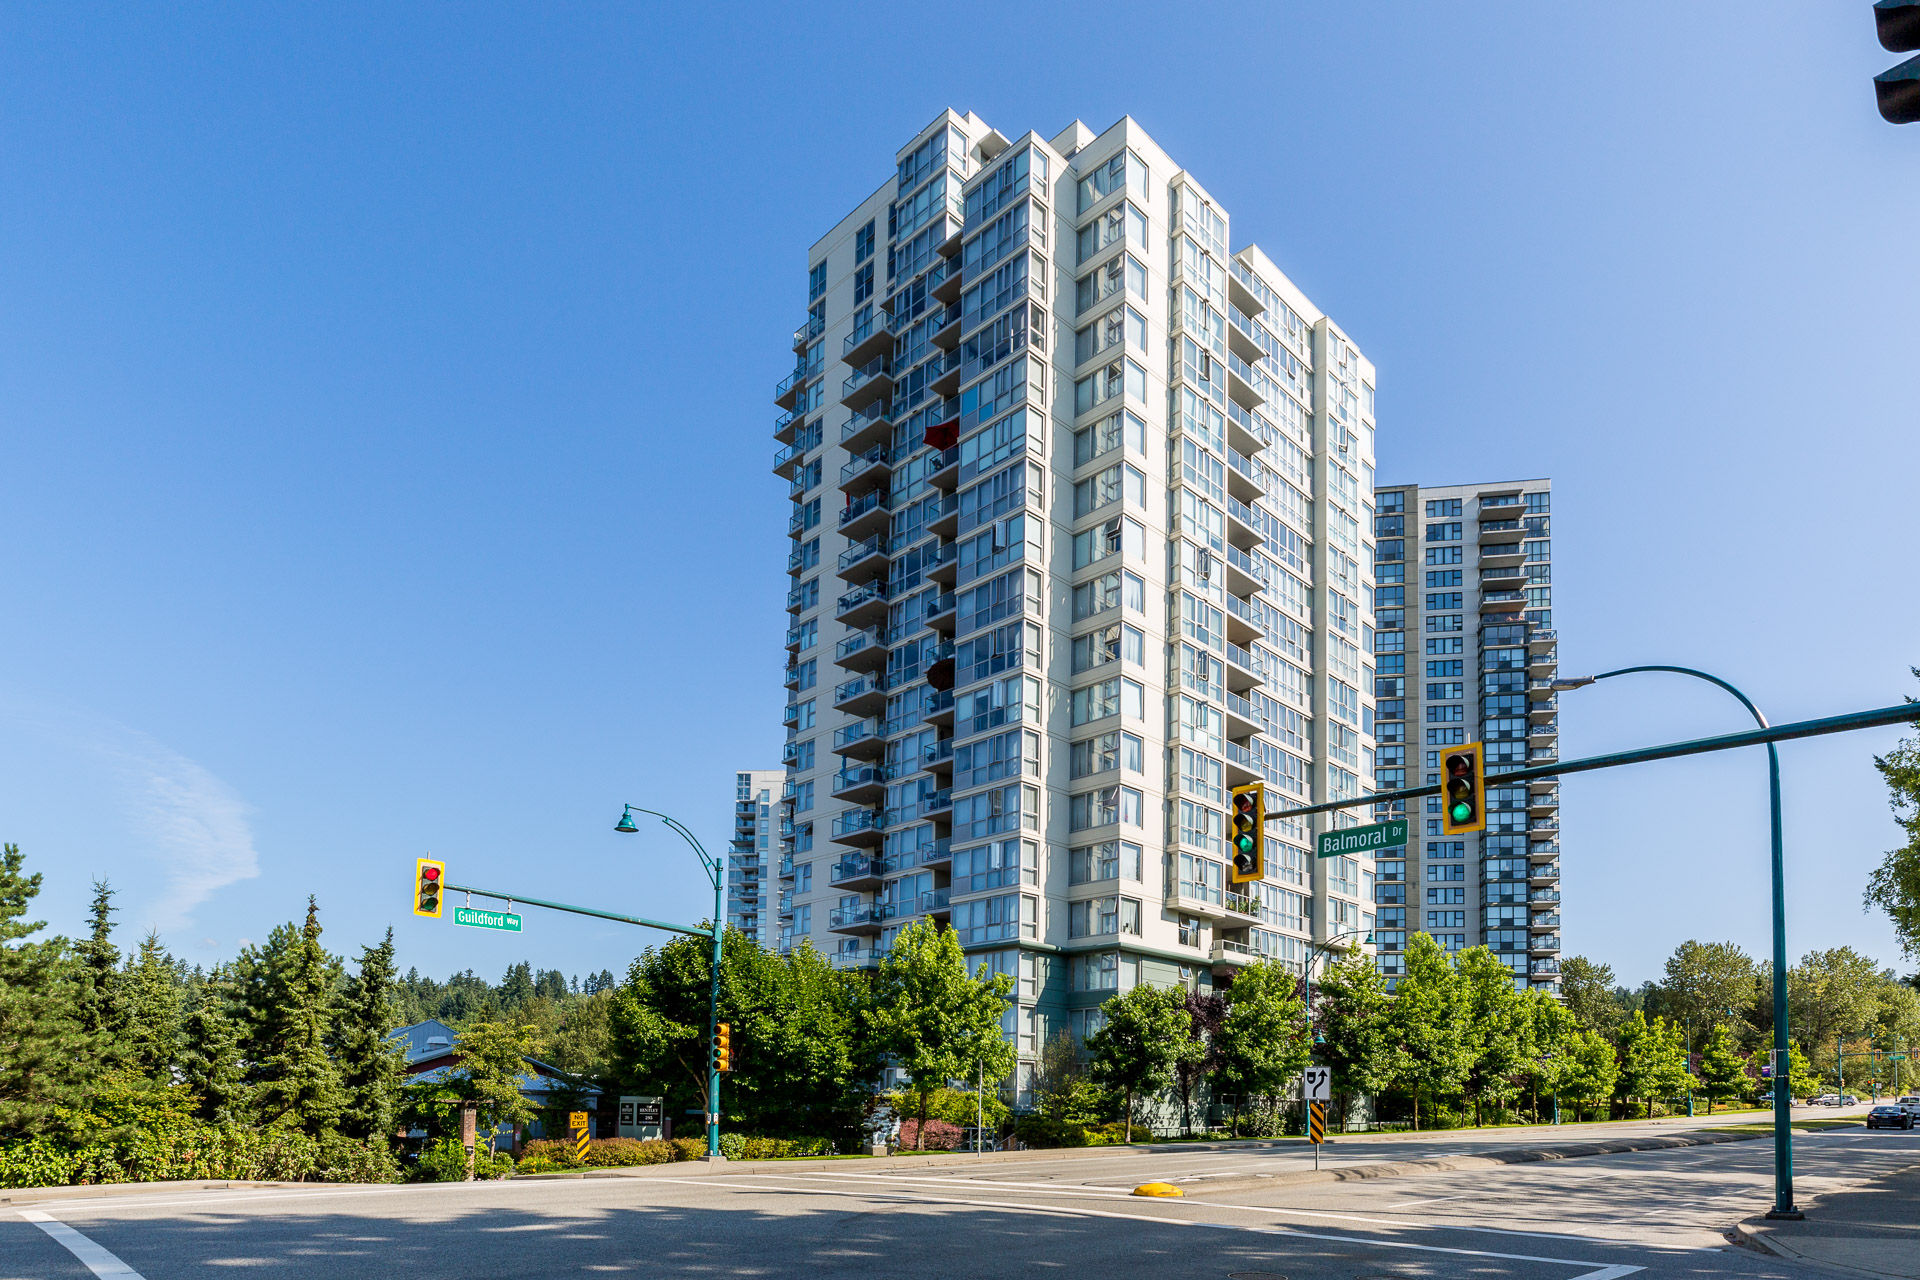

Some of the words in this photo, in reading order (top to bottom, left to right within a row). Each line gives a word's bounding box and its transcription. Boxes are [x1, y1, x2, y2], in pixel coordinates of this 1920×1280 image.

[1323, 826, 1387, 853] Balmoral
[1392, 826, 1402, 836] Dr
[458, 911, 503, 926] Guildford
[507, 917, 518, 927] Way
